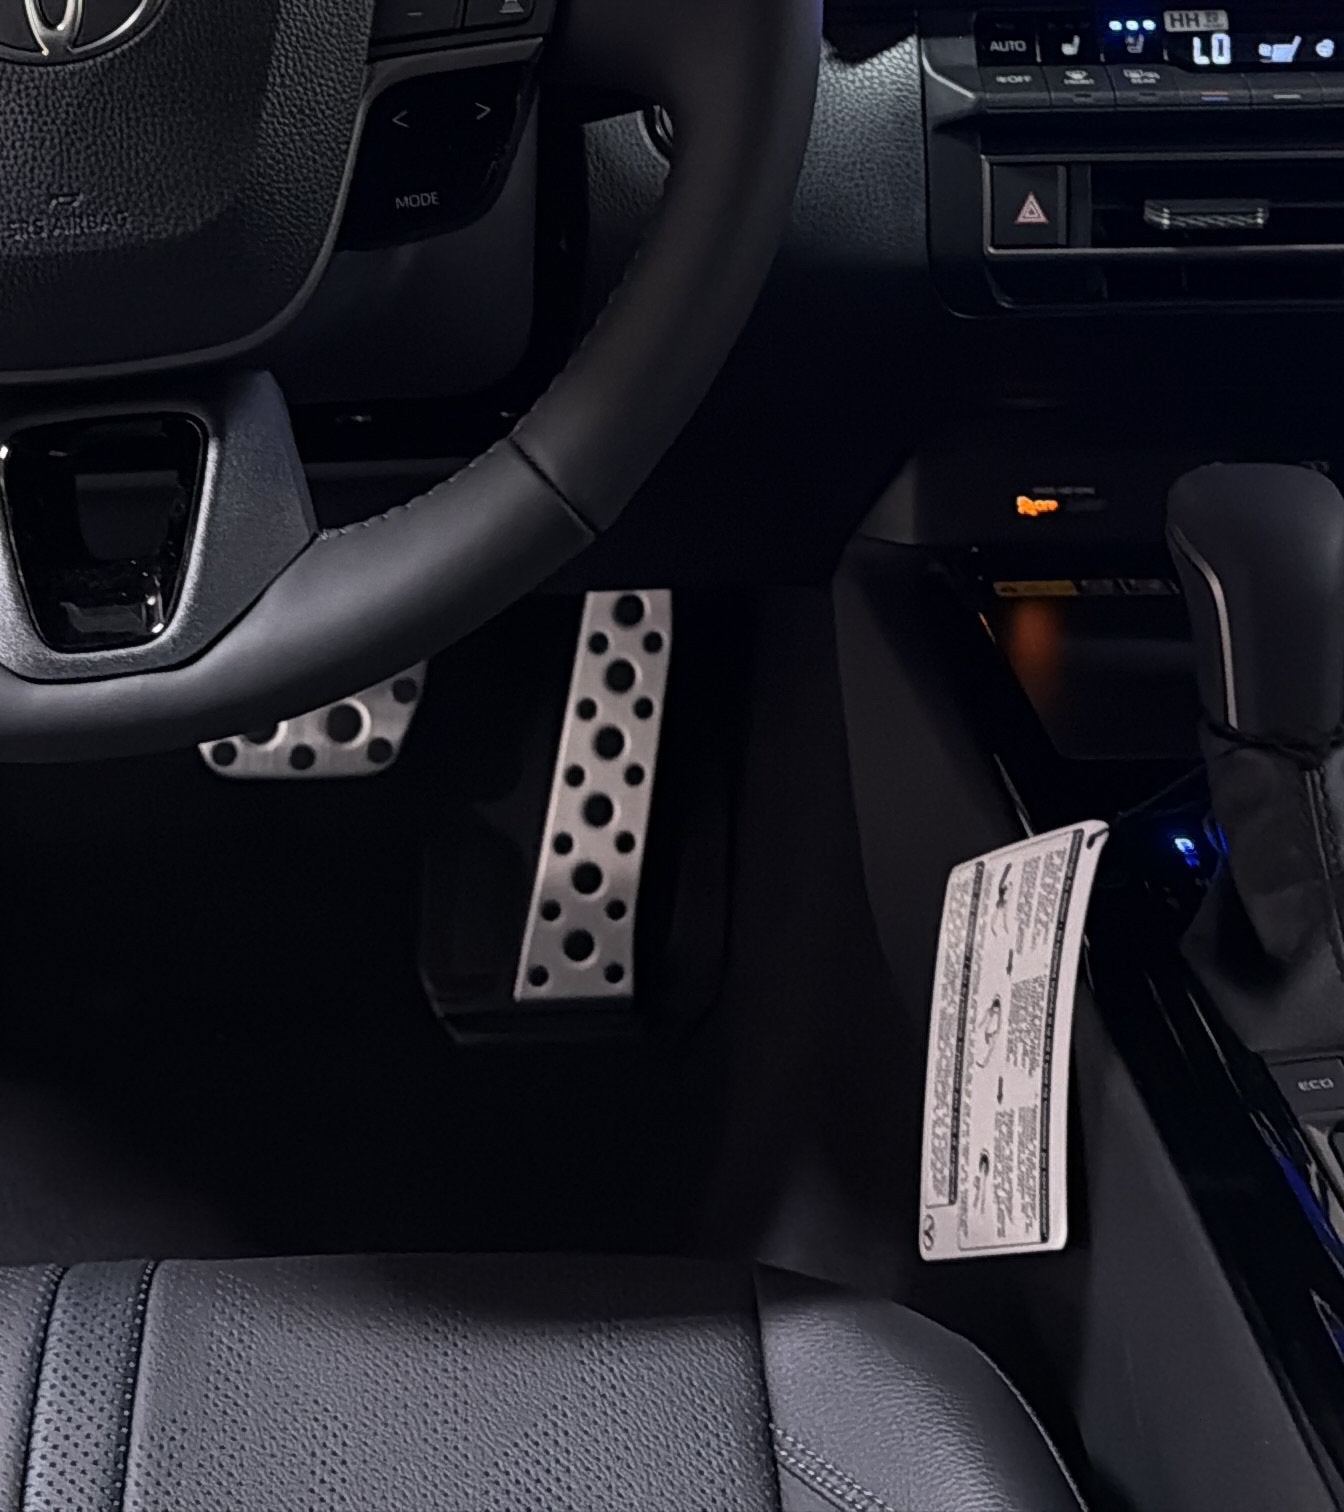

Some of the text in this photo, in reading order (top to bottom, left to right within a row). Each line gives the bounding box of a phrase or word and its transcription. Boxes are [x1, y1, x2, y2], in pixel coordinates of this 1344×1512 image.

[1169, 12, 1200, 29] HH
[989, 39, 1026, 52] AUTO
[395, 191, 440, 210] MODE
[1298, 1078, 1334, 1091] ECO
